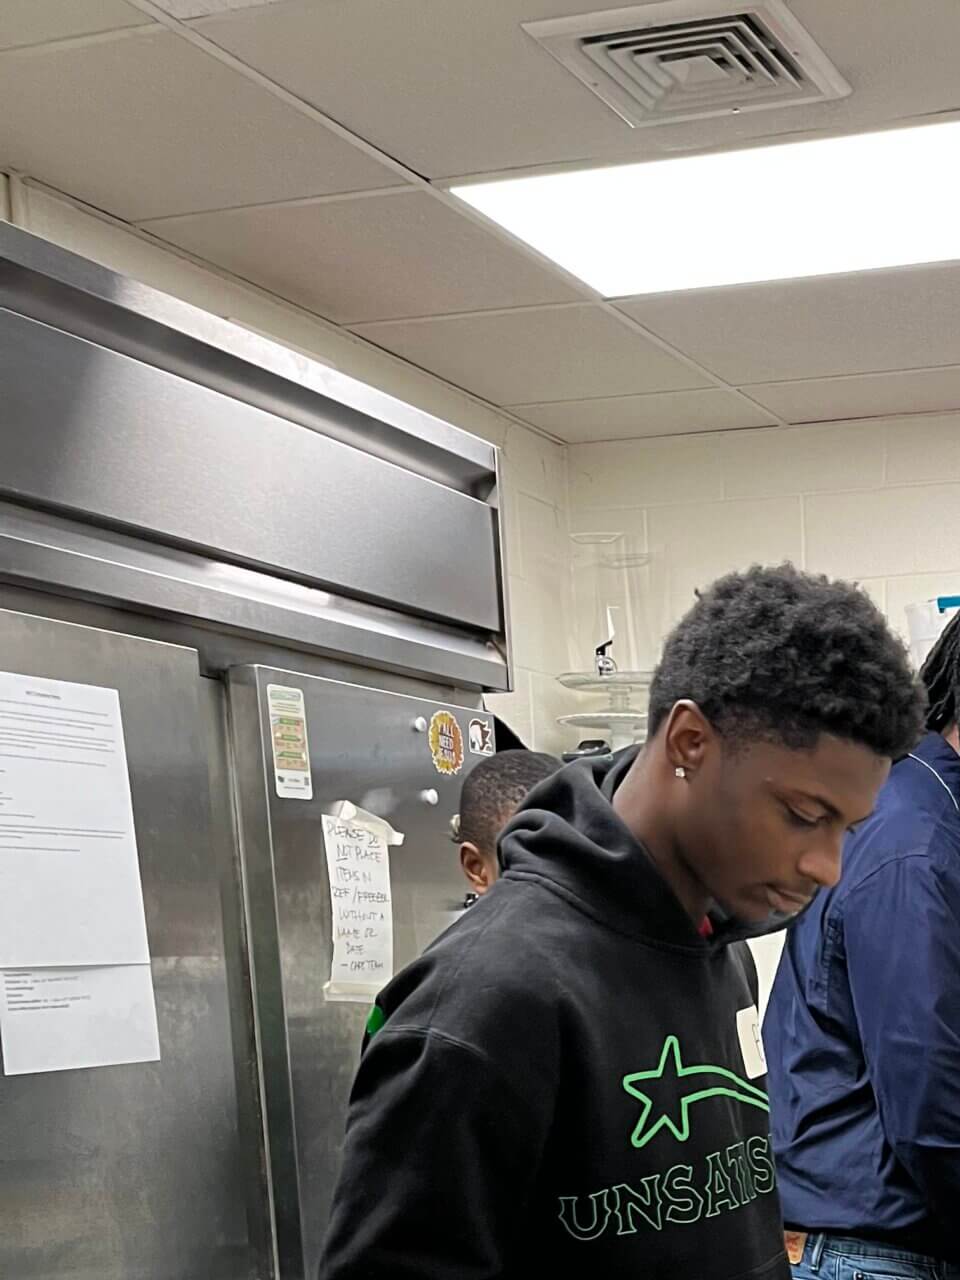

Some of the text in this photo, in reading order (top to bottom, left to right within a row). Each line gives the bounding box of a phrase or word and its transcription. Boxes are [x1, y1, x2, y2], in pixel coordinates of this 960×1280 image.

[327, 820, 364, 841] PLEASE
[336, 843, 353, 859] NOT
[558, 1134, 777, 1241] UNSATIS
